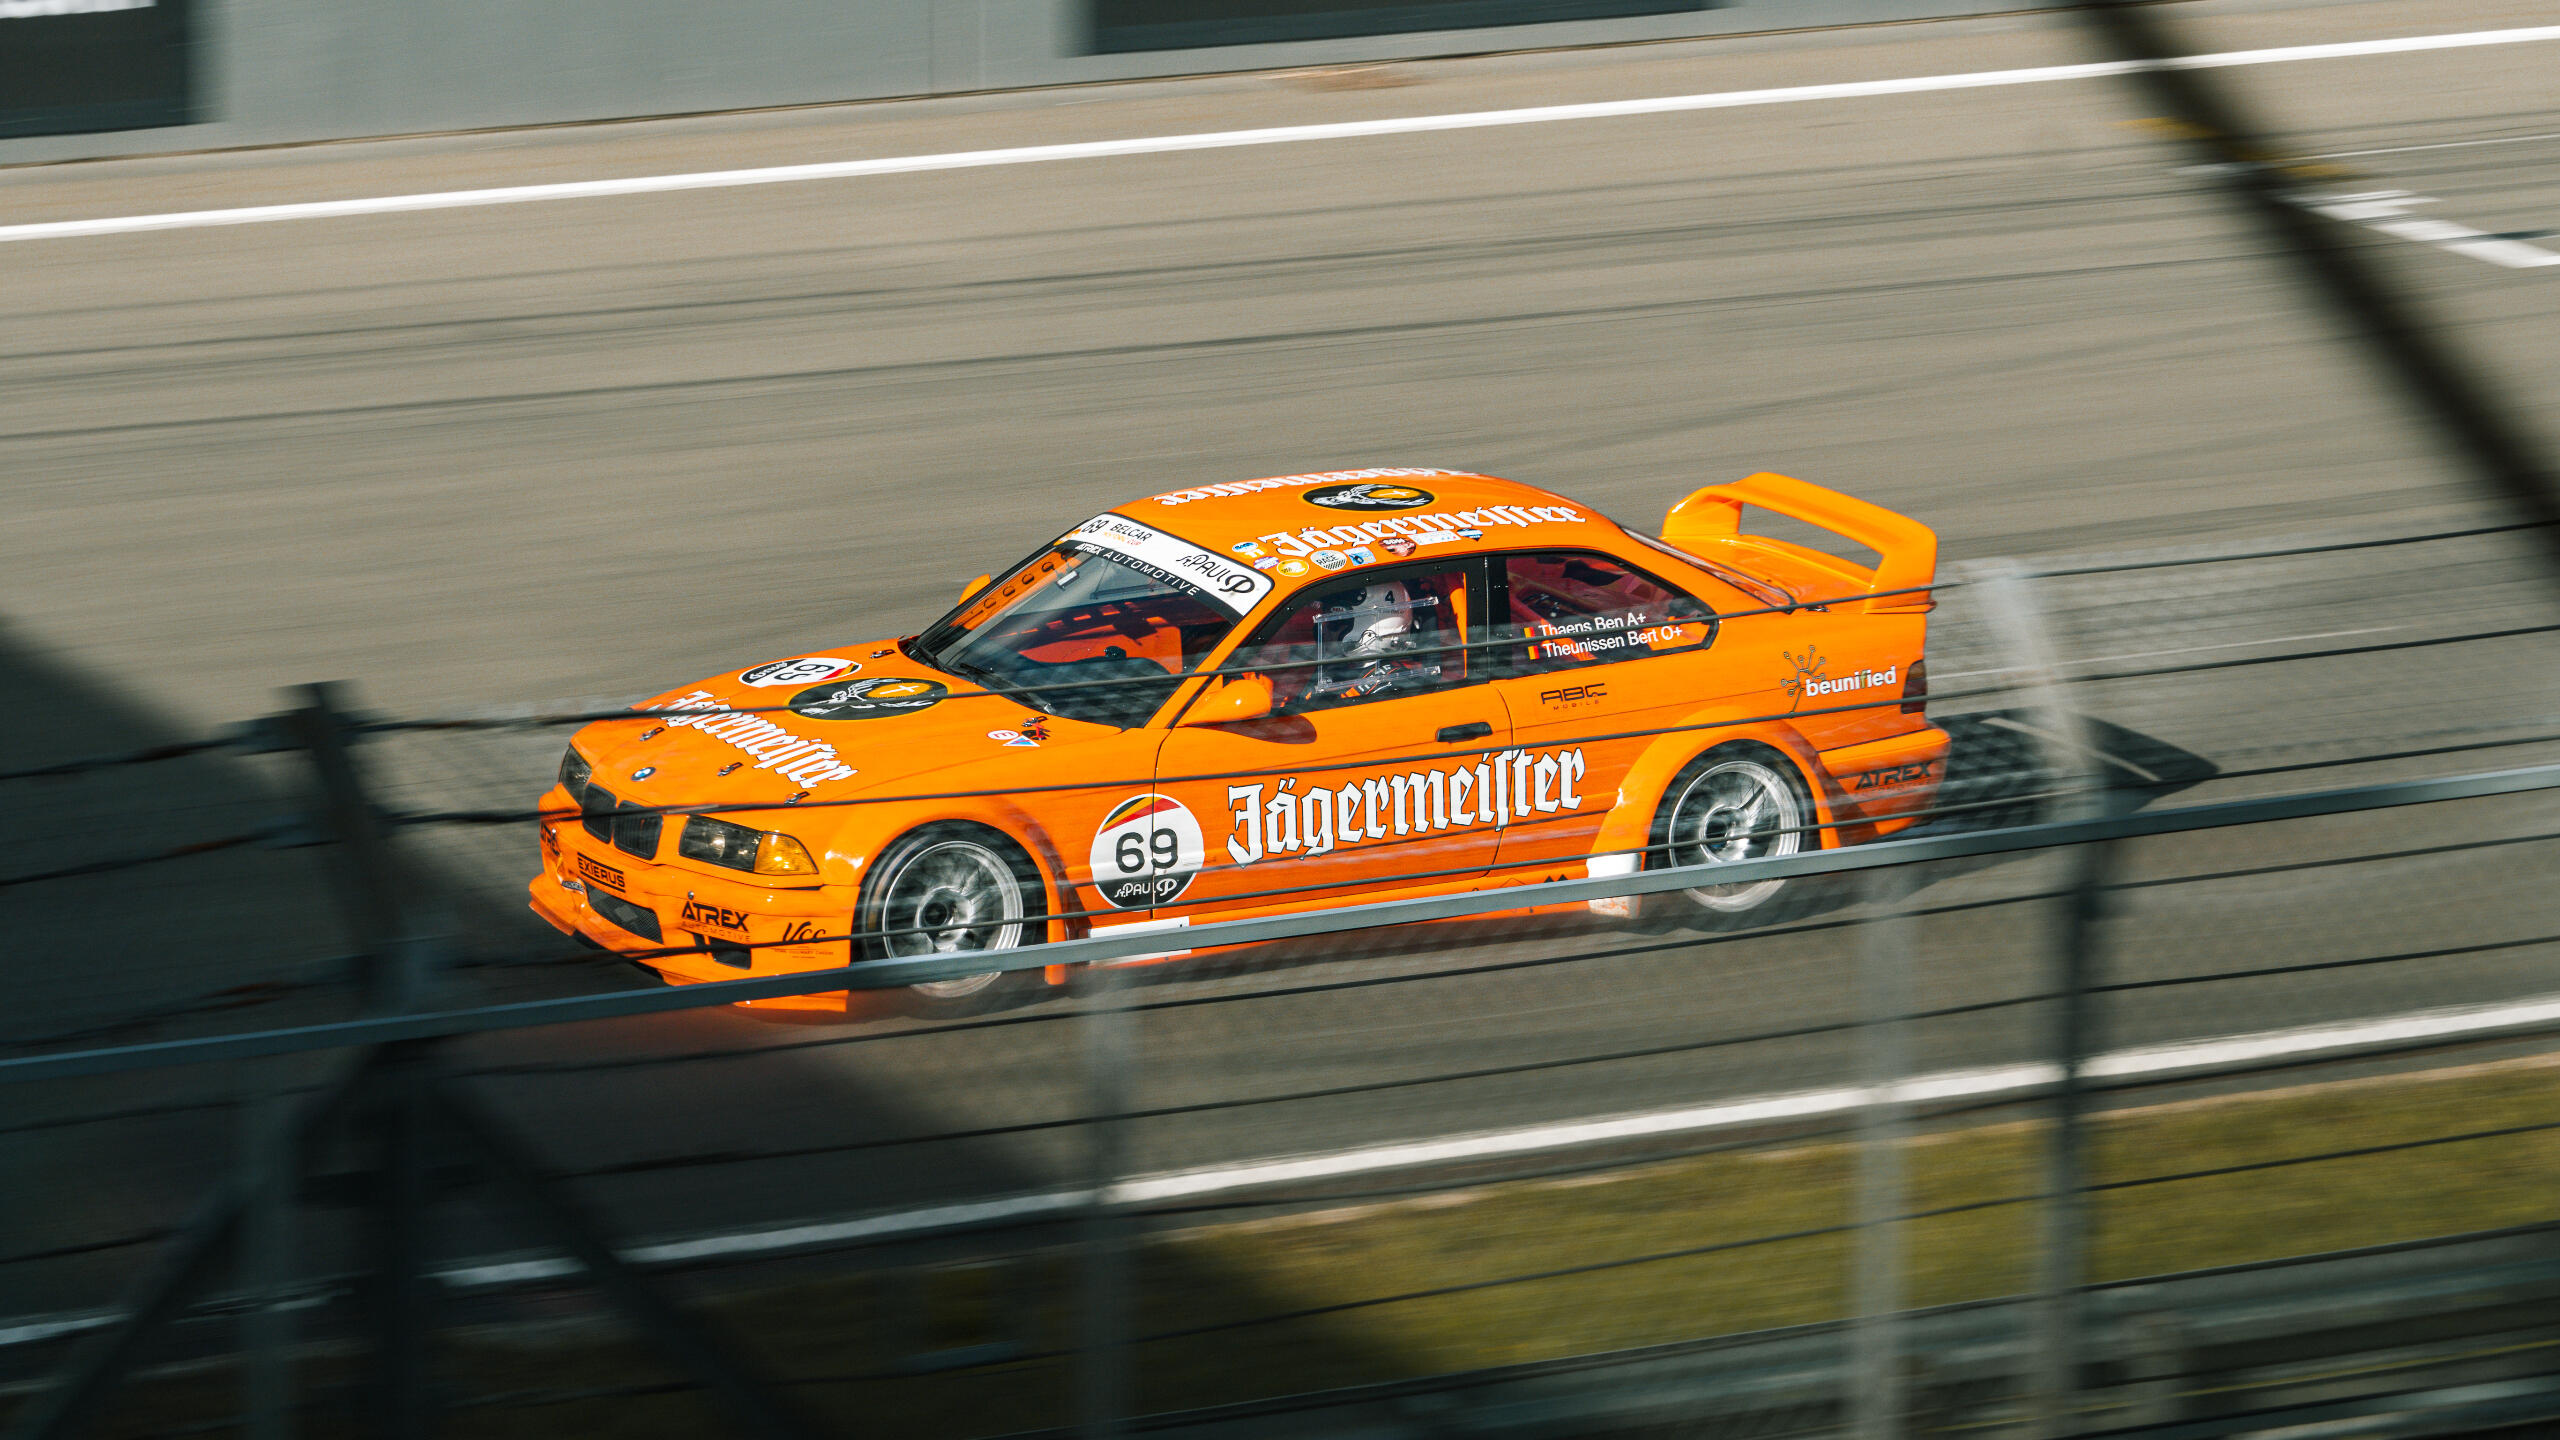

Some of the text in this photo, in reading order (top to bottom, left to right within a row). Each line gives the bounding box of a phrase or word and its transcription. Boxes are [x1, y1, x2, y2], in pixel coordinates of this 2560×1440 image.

[1109, 523, 1153, 542] BELCAR
[1102, 549, 1201, 597] AUTOMOTIVE
[1385, 590, 1395, 604] 4
[1538, 612, 1647, 637] Thaens Ben A+
[1541, 625, 1683, 658] Theunissen Bert O+
[1540, 682, 1608, 704] ABC
[1805, 665, 1897, 696] beunified
[1854, 761, 1937, 791] ATREX
[1115, 827, 1179, 874] 69
[577, 856, 626, 888] EXIERUS
[681, 900, 749, 932] ATREX
